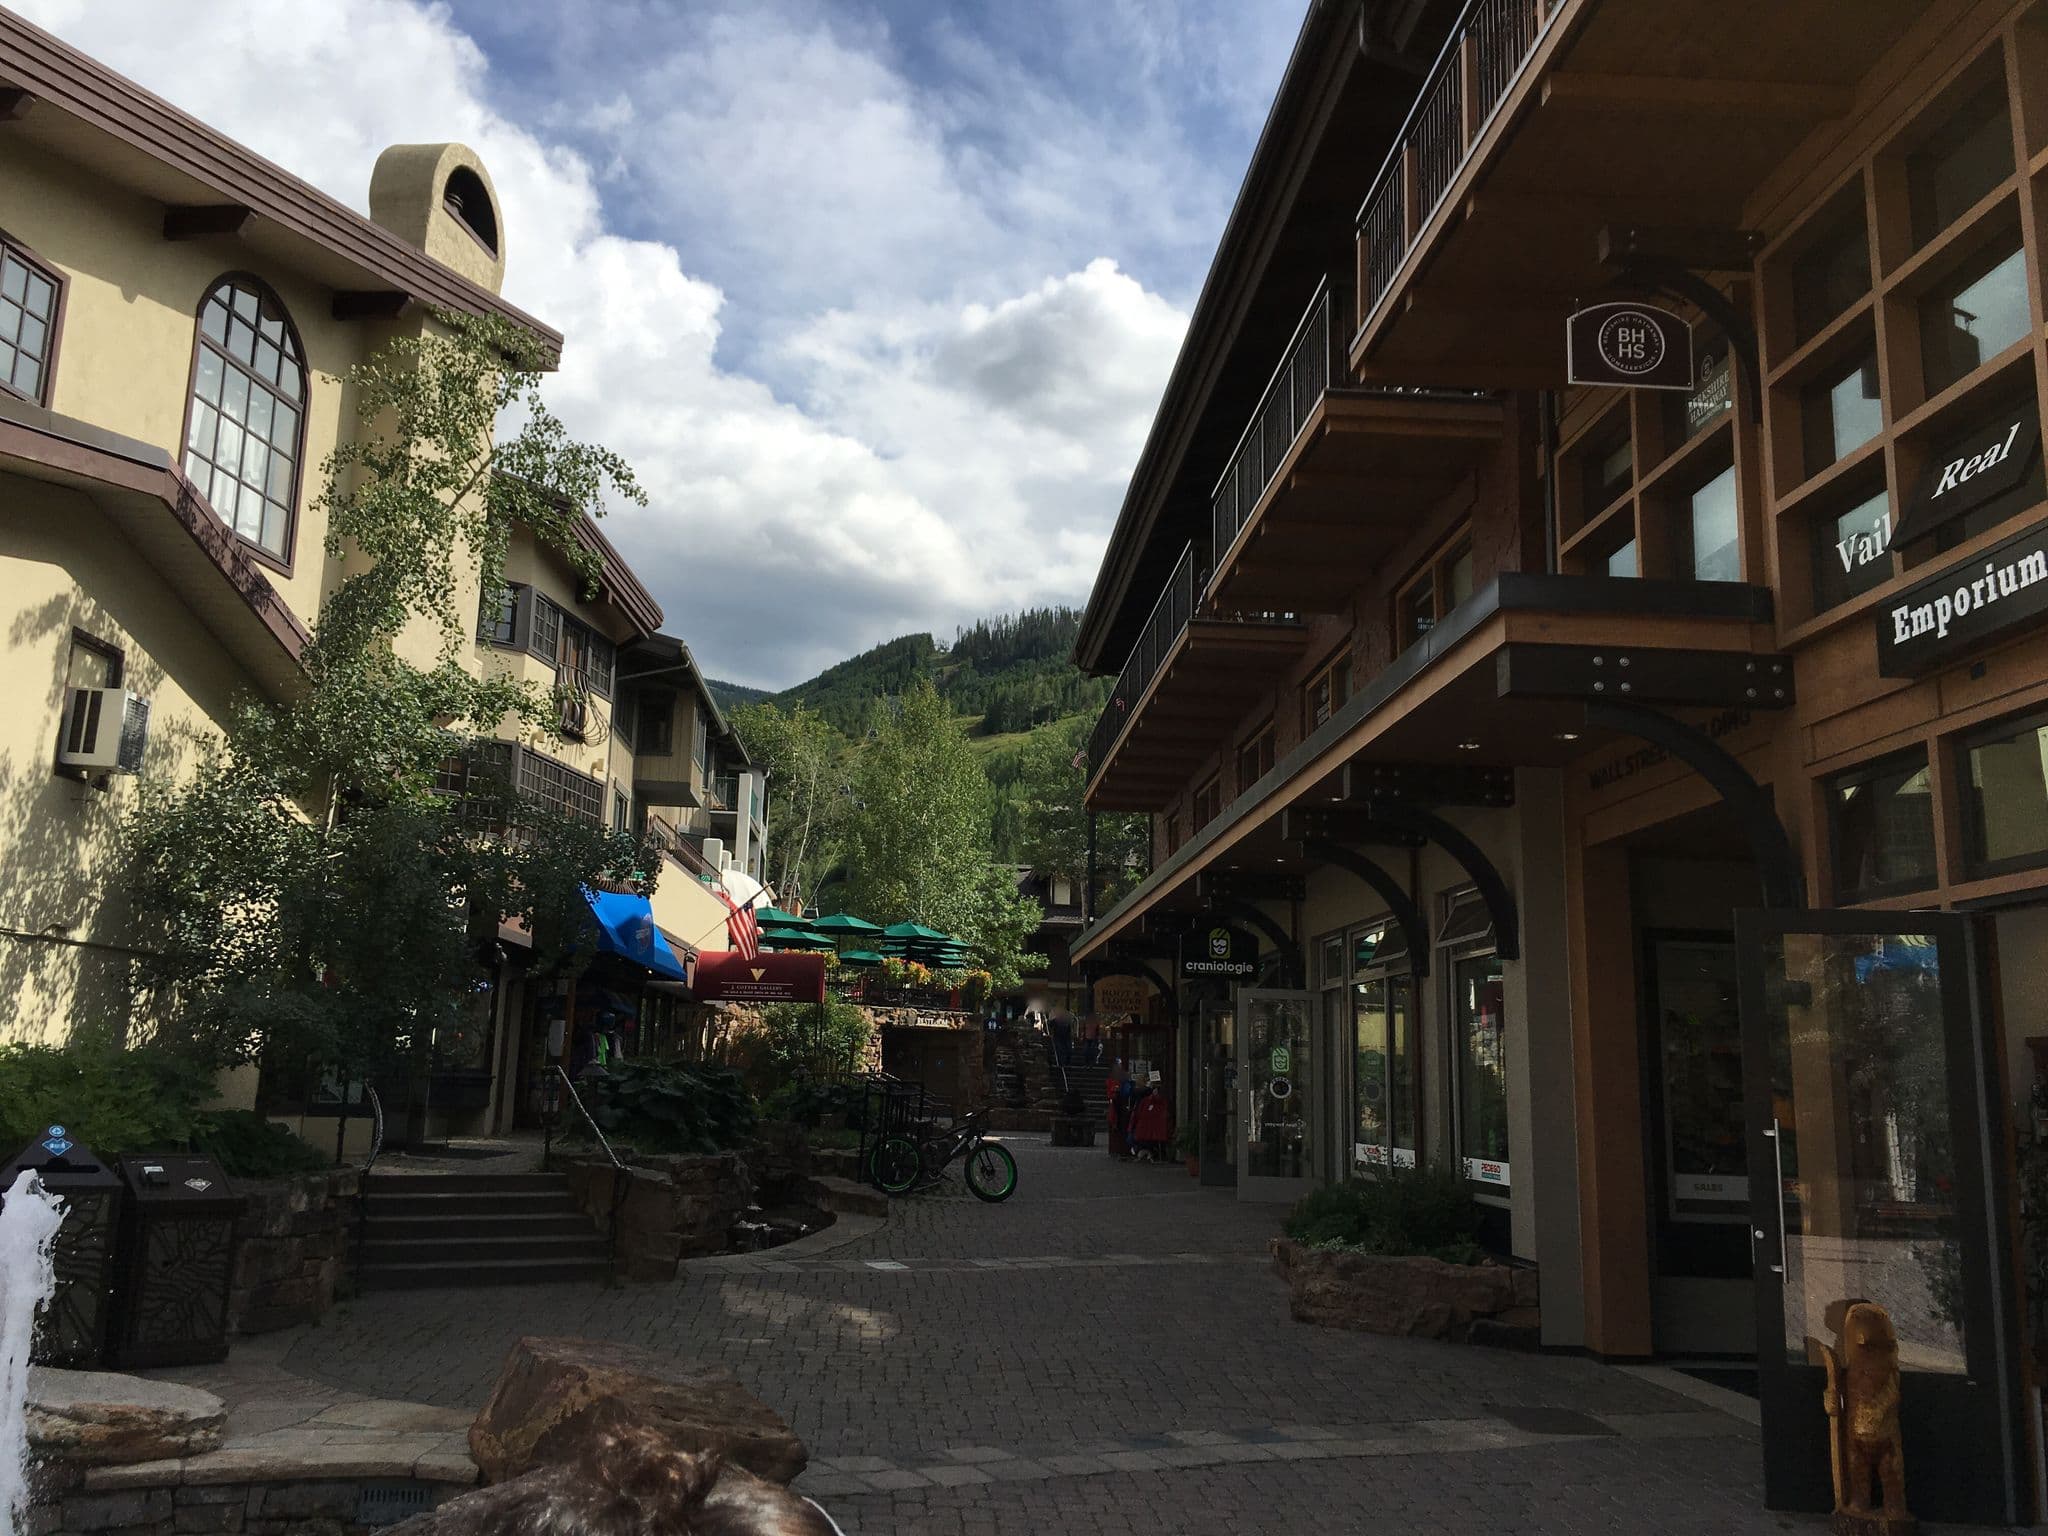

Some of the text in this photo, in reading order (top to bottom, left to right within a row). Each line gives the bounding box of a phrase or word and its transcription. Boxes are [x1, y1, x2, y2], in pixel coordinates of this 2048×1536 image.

[1618, 327, 1645, 343] BH
[1618, 343, 1645, 359] HS
[1930, 420, 2022, 500] Real
[1835, 511, 1892, 575] Vail
[1891, 548, 2048, 645] Emporium
[1185, 960, 1255, 975] craniologie
